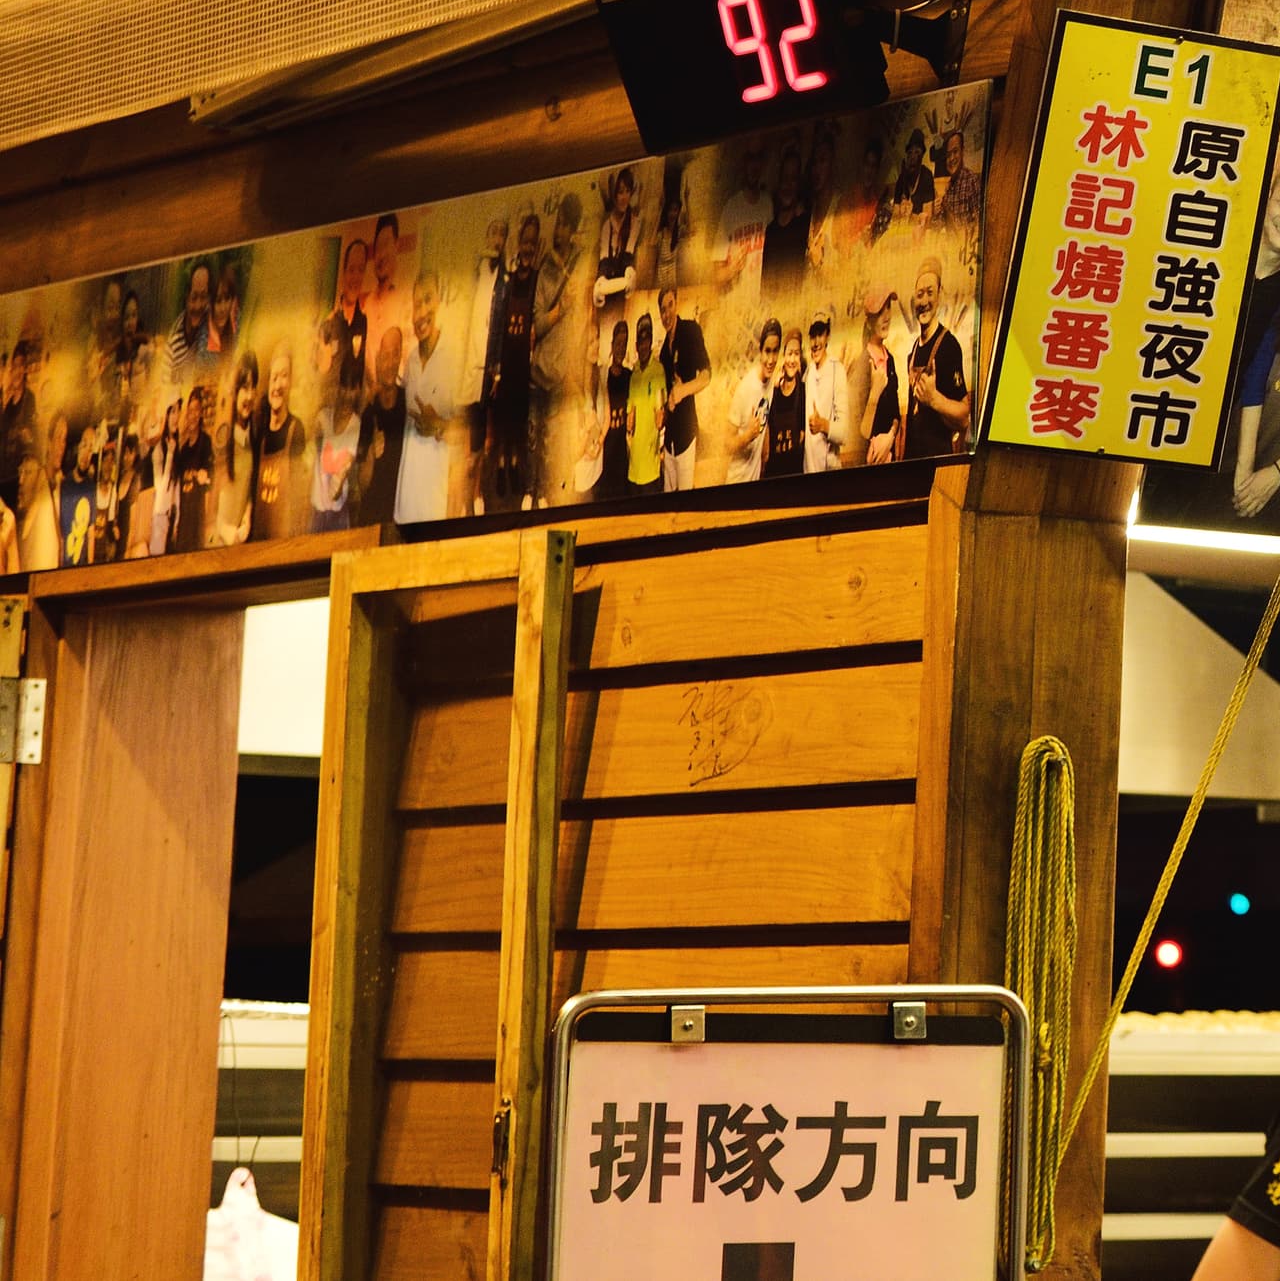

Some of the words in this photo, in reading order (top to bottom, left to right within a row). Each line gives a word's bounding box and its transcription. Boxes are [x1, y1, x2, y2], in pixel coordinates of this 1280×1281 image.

[1131, 44, 1211, 106] E1
[1029, 104, 1149, 440] 林記燒番麥
[1124, 119, 1246, 449] 原自強夜市
[588, 1099, 980, 1205] 排隊方向
